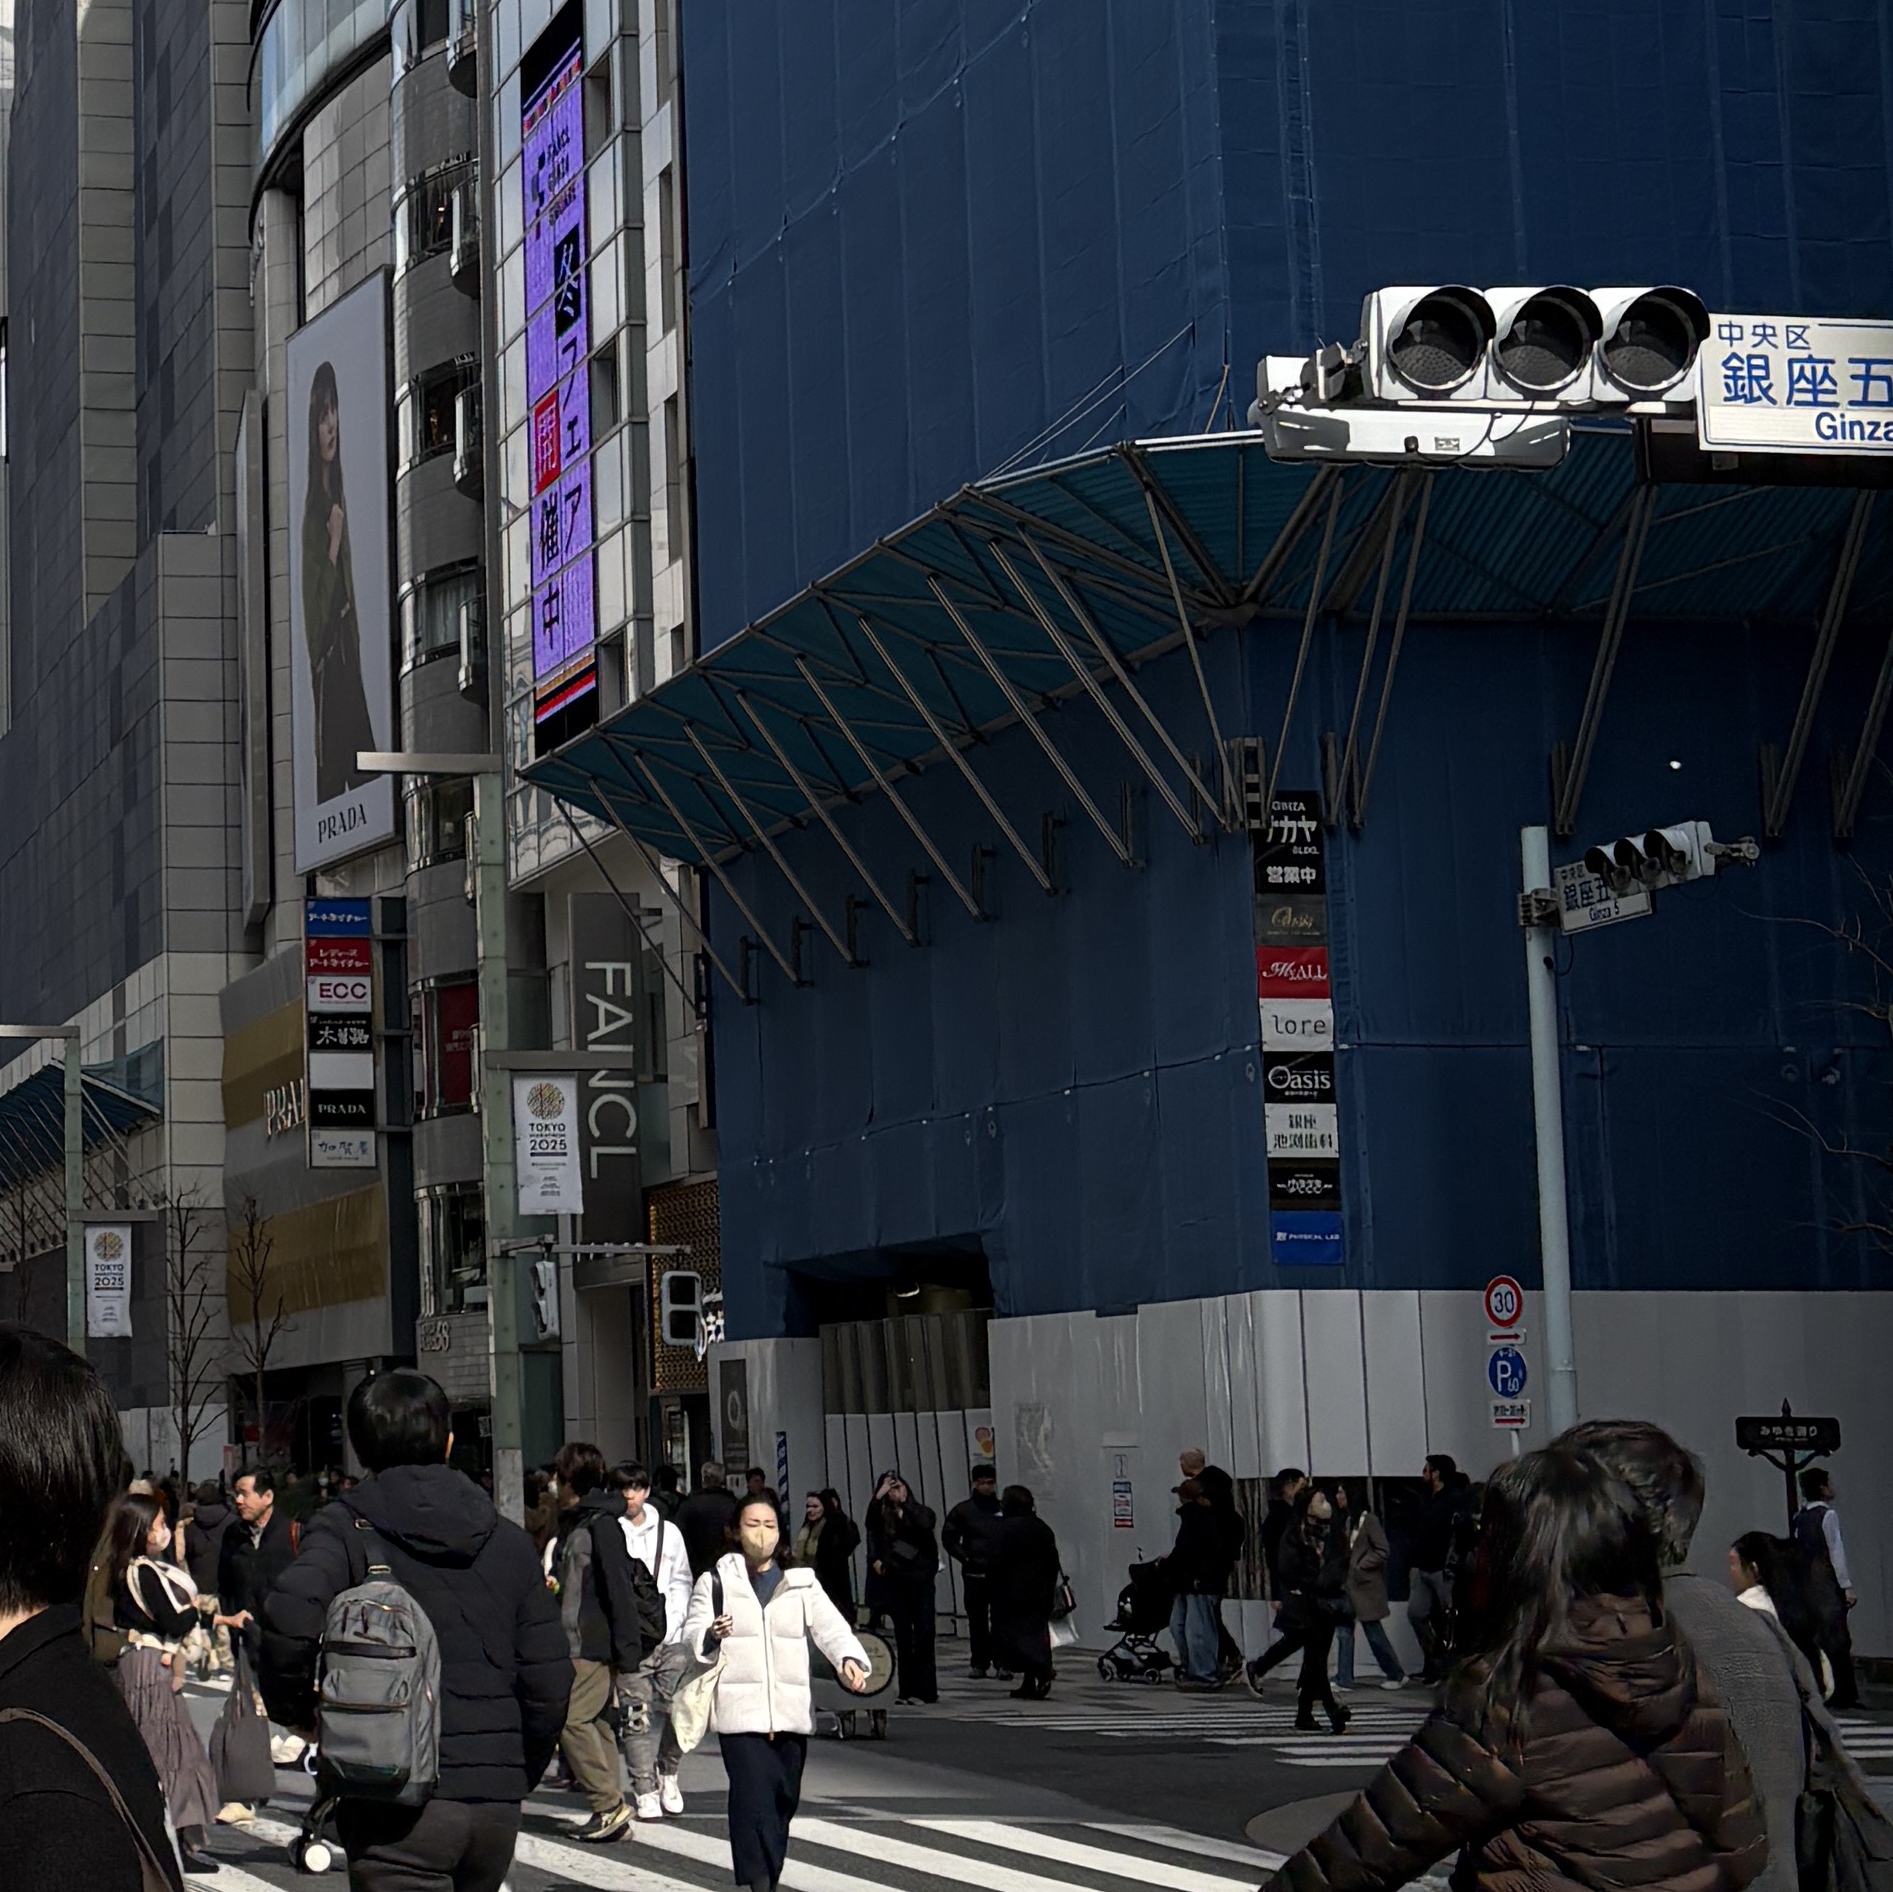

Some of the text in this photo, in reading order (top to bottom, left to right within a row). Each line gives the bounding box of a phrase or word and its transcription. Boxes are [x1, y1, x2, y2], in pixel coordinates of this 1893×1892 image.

[1718, 321, 1812, 350] 中央区
[1721, 352, 1893, 408] 銀座五
[1815, 411, 1893, 442] Ginza
[318, 803, 367, 844] PRADA
[319, 982, 367, 999] ECC
[1272, 1014, 1326, 1035] lore
[585, 962, 637, 1179] FANCL
[1268, 1065, 1331, 1089] Oasis
[317, 1104, 367, 1114] PRADA
[528, 1122, 567, 1132] TOKYO
[529, 1139, 567, 1151] 2025
[94, 1277, 124, 1286] 2025
[1494, 1291, 1515, 1314] 30
